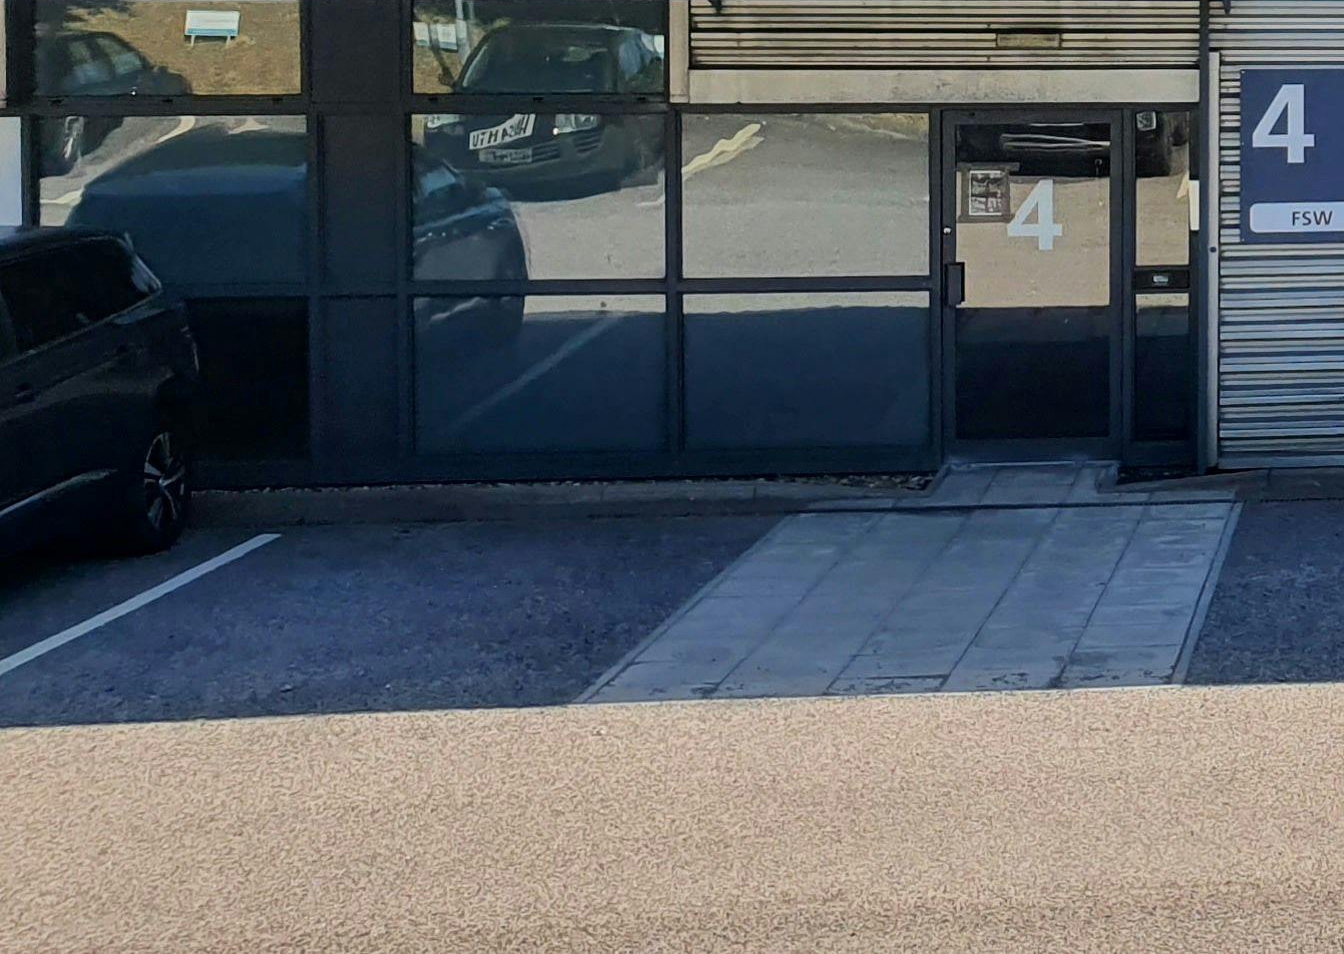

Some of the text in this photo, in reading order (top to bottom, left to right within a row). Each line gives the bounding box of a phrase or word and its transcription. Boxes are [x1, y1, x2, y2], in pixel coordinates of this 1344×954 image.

[1252, 83, 1315, 164] 4
[1006, 179, 1063, 251] 4
[1291, 210, 1334, 227] FSW
